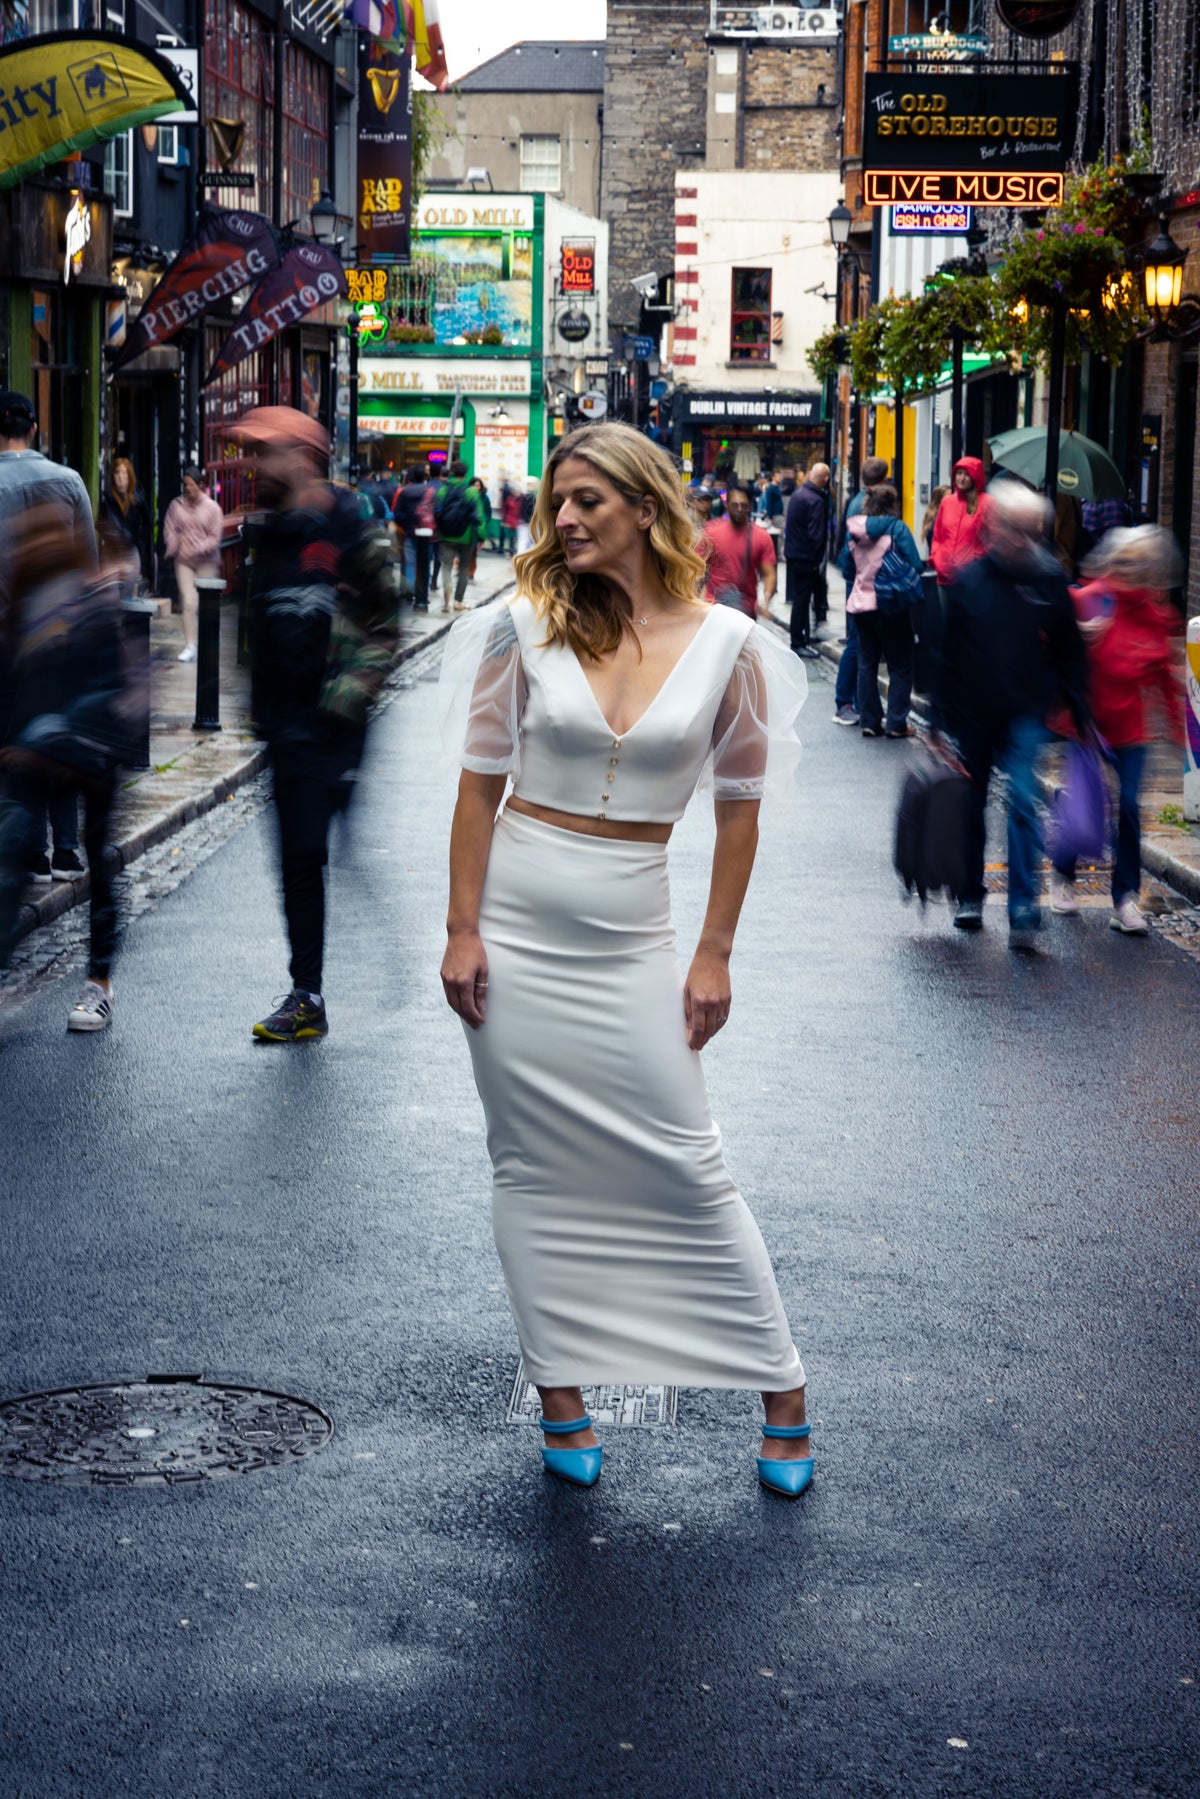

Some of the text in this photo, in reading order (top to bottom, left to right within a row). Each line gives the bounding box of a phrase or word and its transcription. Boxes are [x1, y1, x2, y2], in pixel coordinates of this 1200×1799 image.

[0, 75, 62, 132] ity
[871, 91, 948, 113] The OLD
[877, 115, 1058, 137] STOREHOUSE
[980, 141, 1062, 160] Bar & Restaurant
[200, 174, 251, 185] GUINNESS
[362, 178, 403, 196] BAD
[873, 176, 1057, 201] LIVE MUSIC
[361, 195, 402, 214] ASS
[228, 215, 254, 235] CRU
[424, 207, 467, 226] OLD
[473, 207, 525, 226] MILL
[895, 214, 921, 227] FISH
[935, 214, 965, 227] CHIPS
[299, 247, 322, 264] CRU
[563, 255, 593, 270] OLD
[344, 269, 387, 287] BAD
[563, 269, 592, 285] MILL
[140, 248, 268, 341] PIERCING
[348, 286, 386, 302] ASS
[234, 272, 338, 350] TATTOO
[372, 372, 423, 390] MILL
[436, 374, 497, 383] TRADITIONAL
[690, 400, 813, 416] DUBLIN VINTAGE FACTORY
[358, 420, 389, 431] MPLE
[394, 420, 424, 431] TAKE
